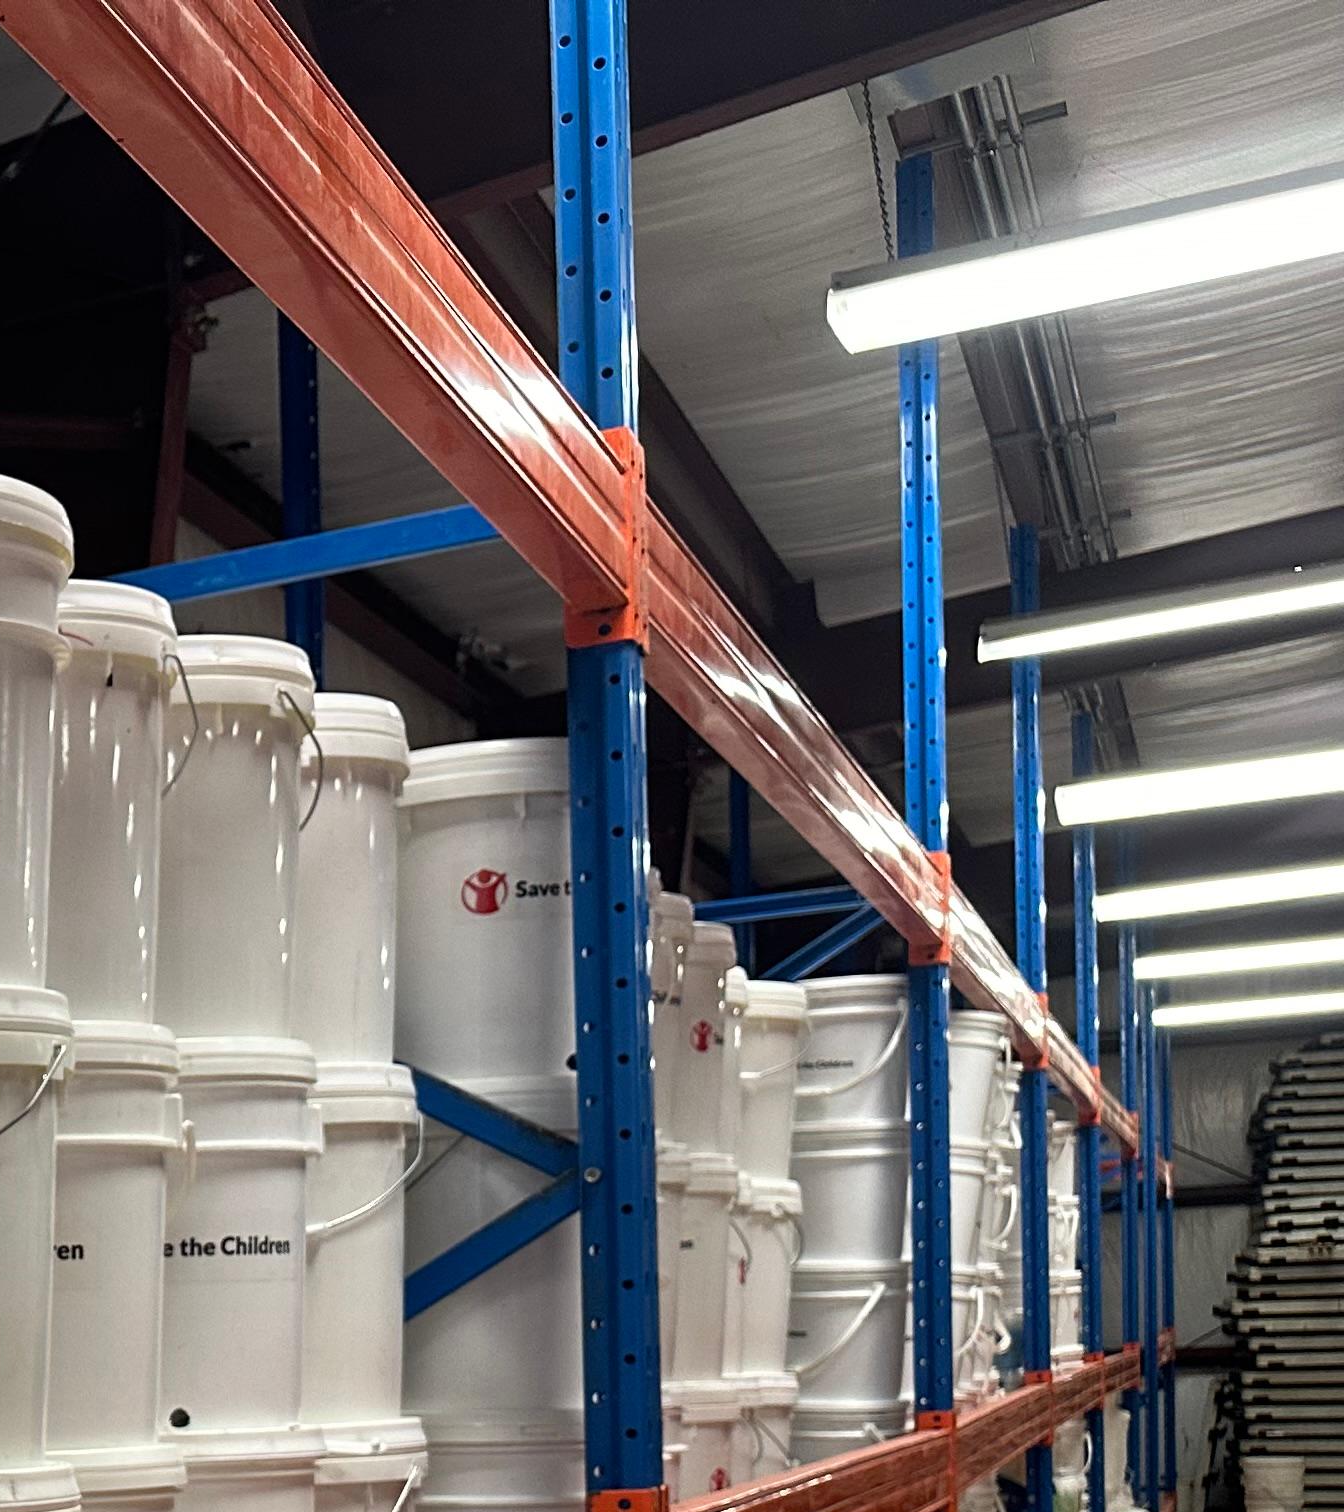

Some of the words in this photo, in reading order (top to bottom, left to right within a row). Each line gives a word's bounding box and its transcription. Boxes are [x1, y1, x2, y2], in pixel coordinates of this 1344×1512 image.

[515, 880, 561, 898] Save
[180, 1237, 216, 1257] the
[220, 1236, 290, 1256] Children
